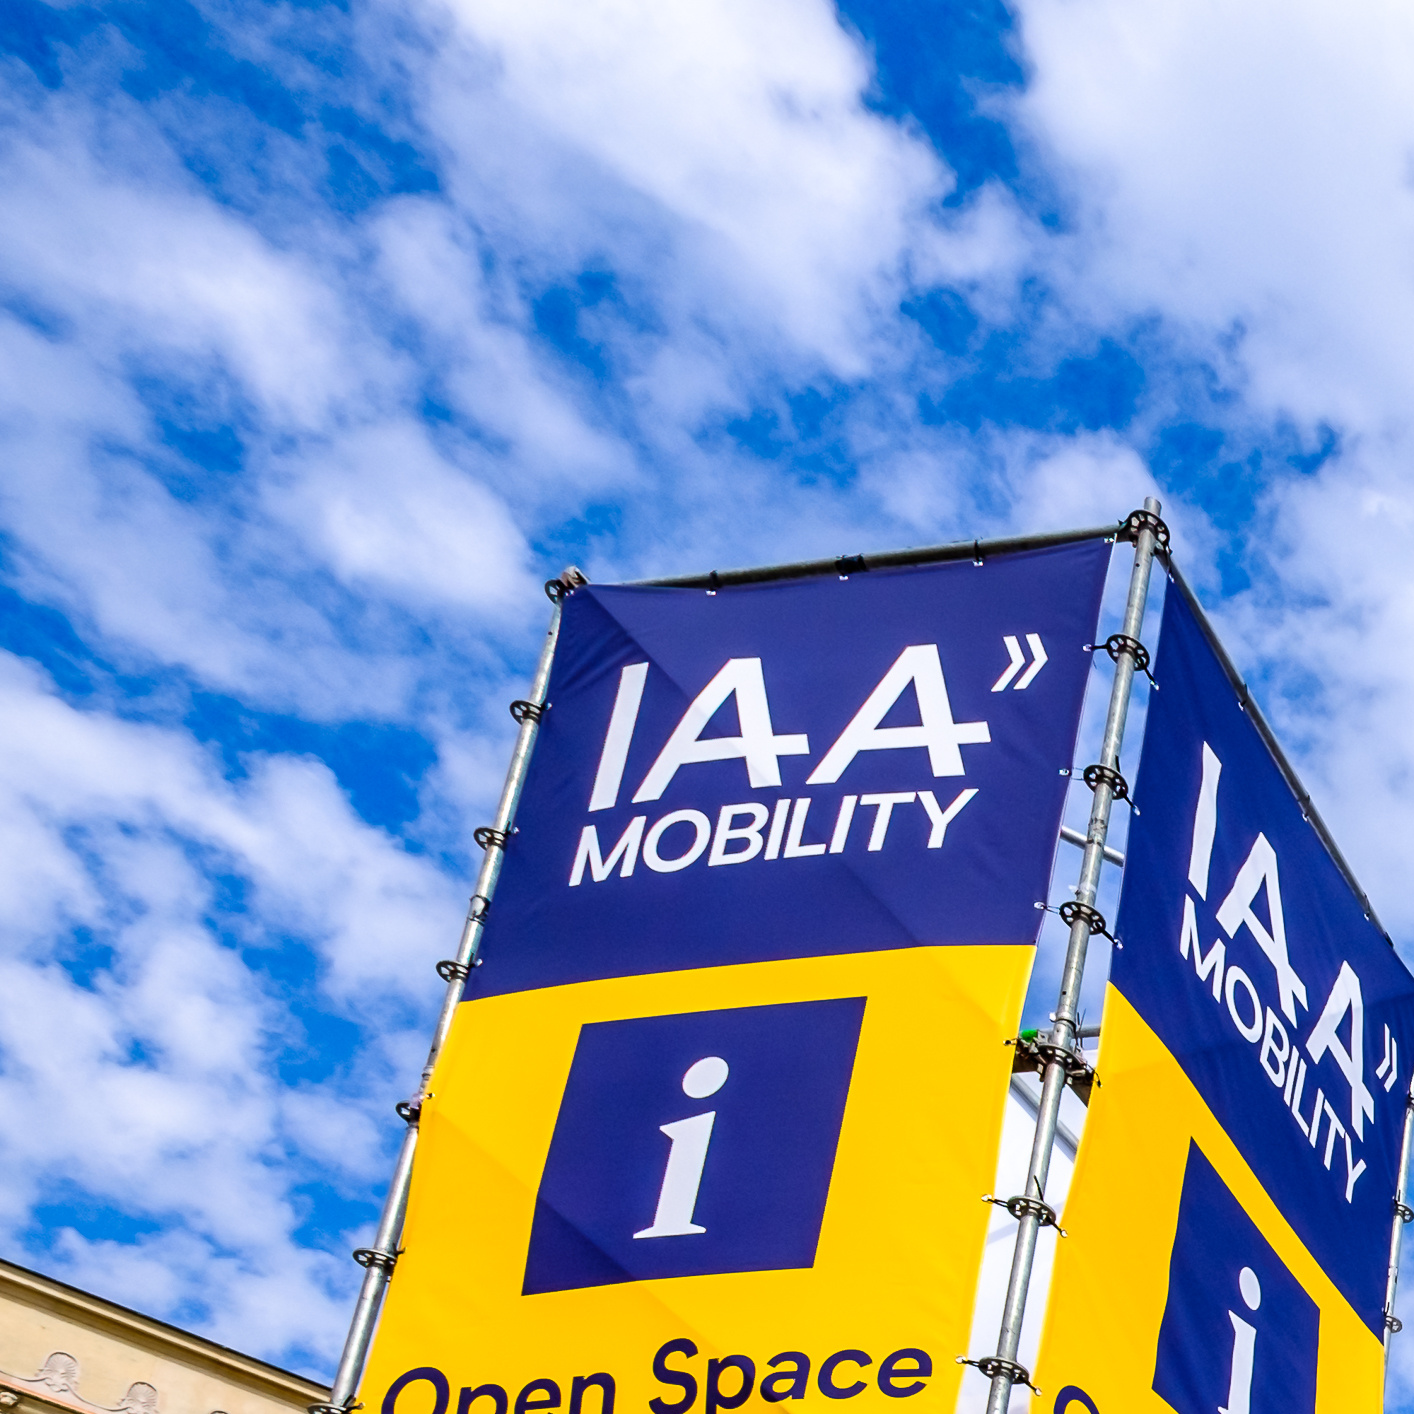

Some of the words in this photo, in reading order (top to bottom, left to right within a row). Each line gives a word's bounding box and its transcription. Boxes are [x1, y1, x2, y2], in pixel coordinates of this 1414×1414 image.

[568, 788, 977, 887] MOBILITY
[588, 642, 990, 812] IAA
[1179, 897, 1366, 1202] MOBILITY
[1187, 741, 1375, 1139] IAA
